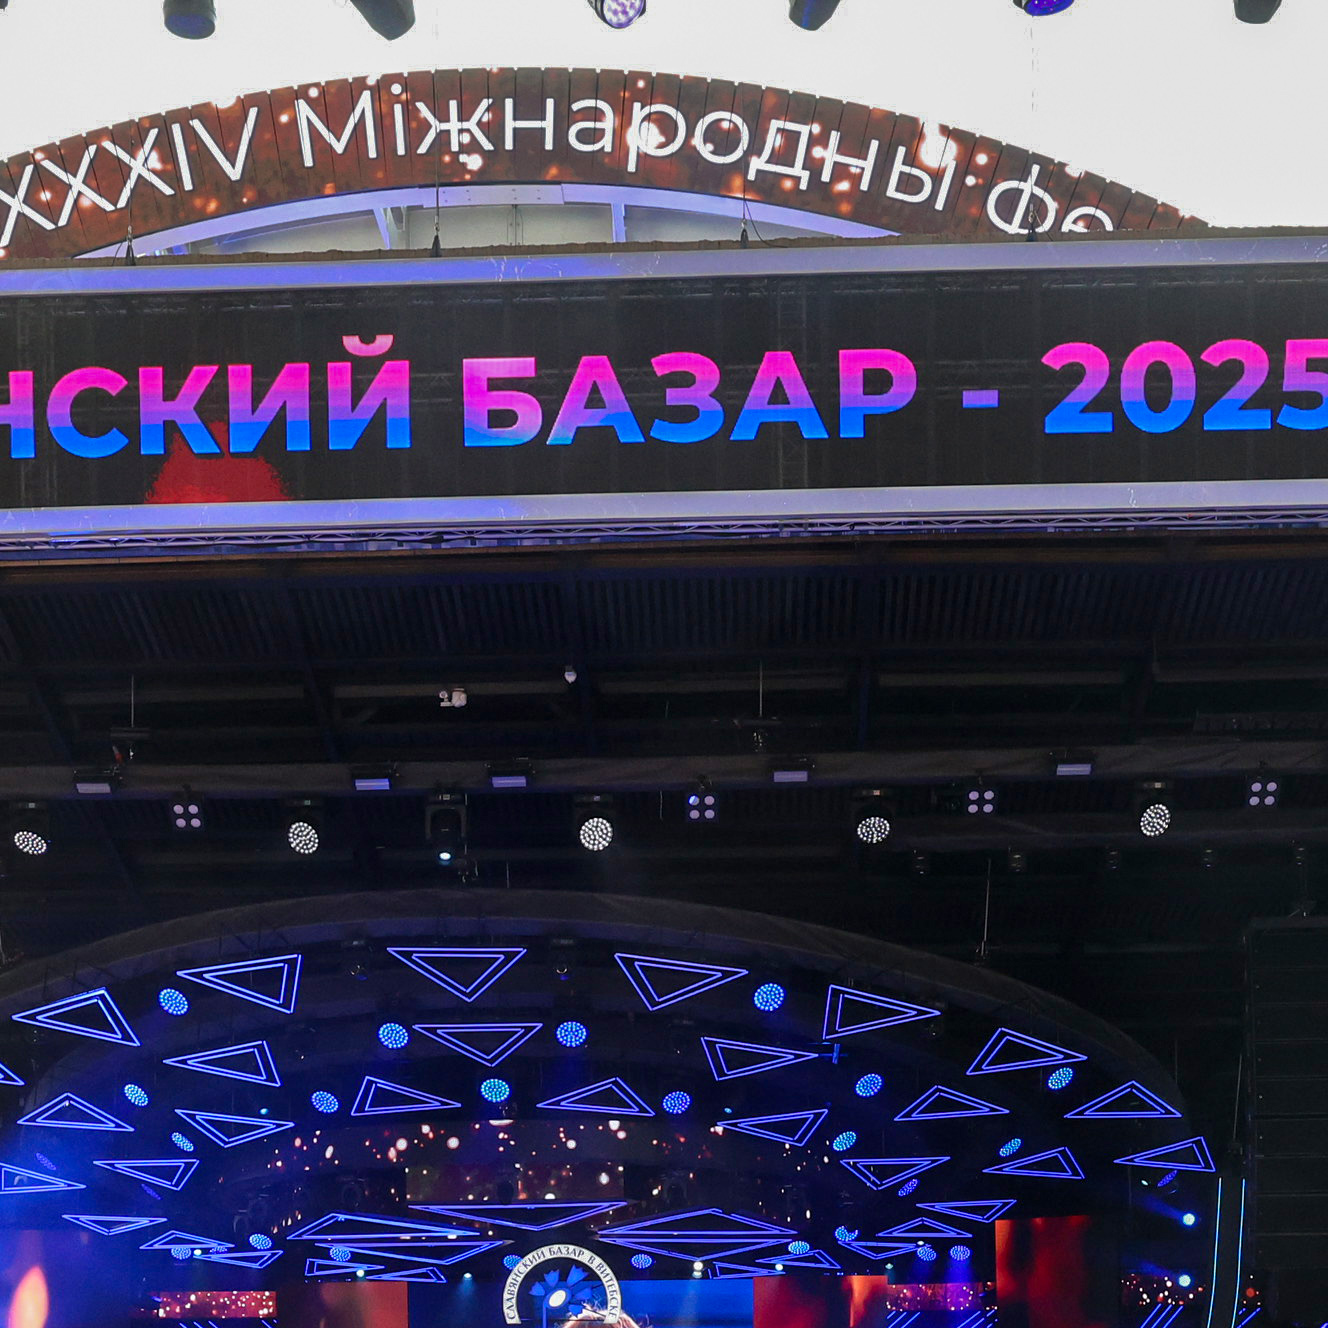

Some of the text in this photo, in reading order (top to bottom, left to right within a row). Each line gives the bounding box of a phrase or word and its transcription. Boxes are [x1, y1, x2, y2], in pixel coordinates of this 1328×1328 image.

[296, 83, 958, 210] Міжнародны
[462, 348, 918, 447] БАЗАР
[962, 390, 999, 408] -
[506, 1250, 546, 1320] СЛАВЯНСКИЙ
[548, 1246, 584, 1258] БАЗАР
[595, 1262, 618, 1319] ВИТЕБСКЕ
